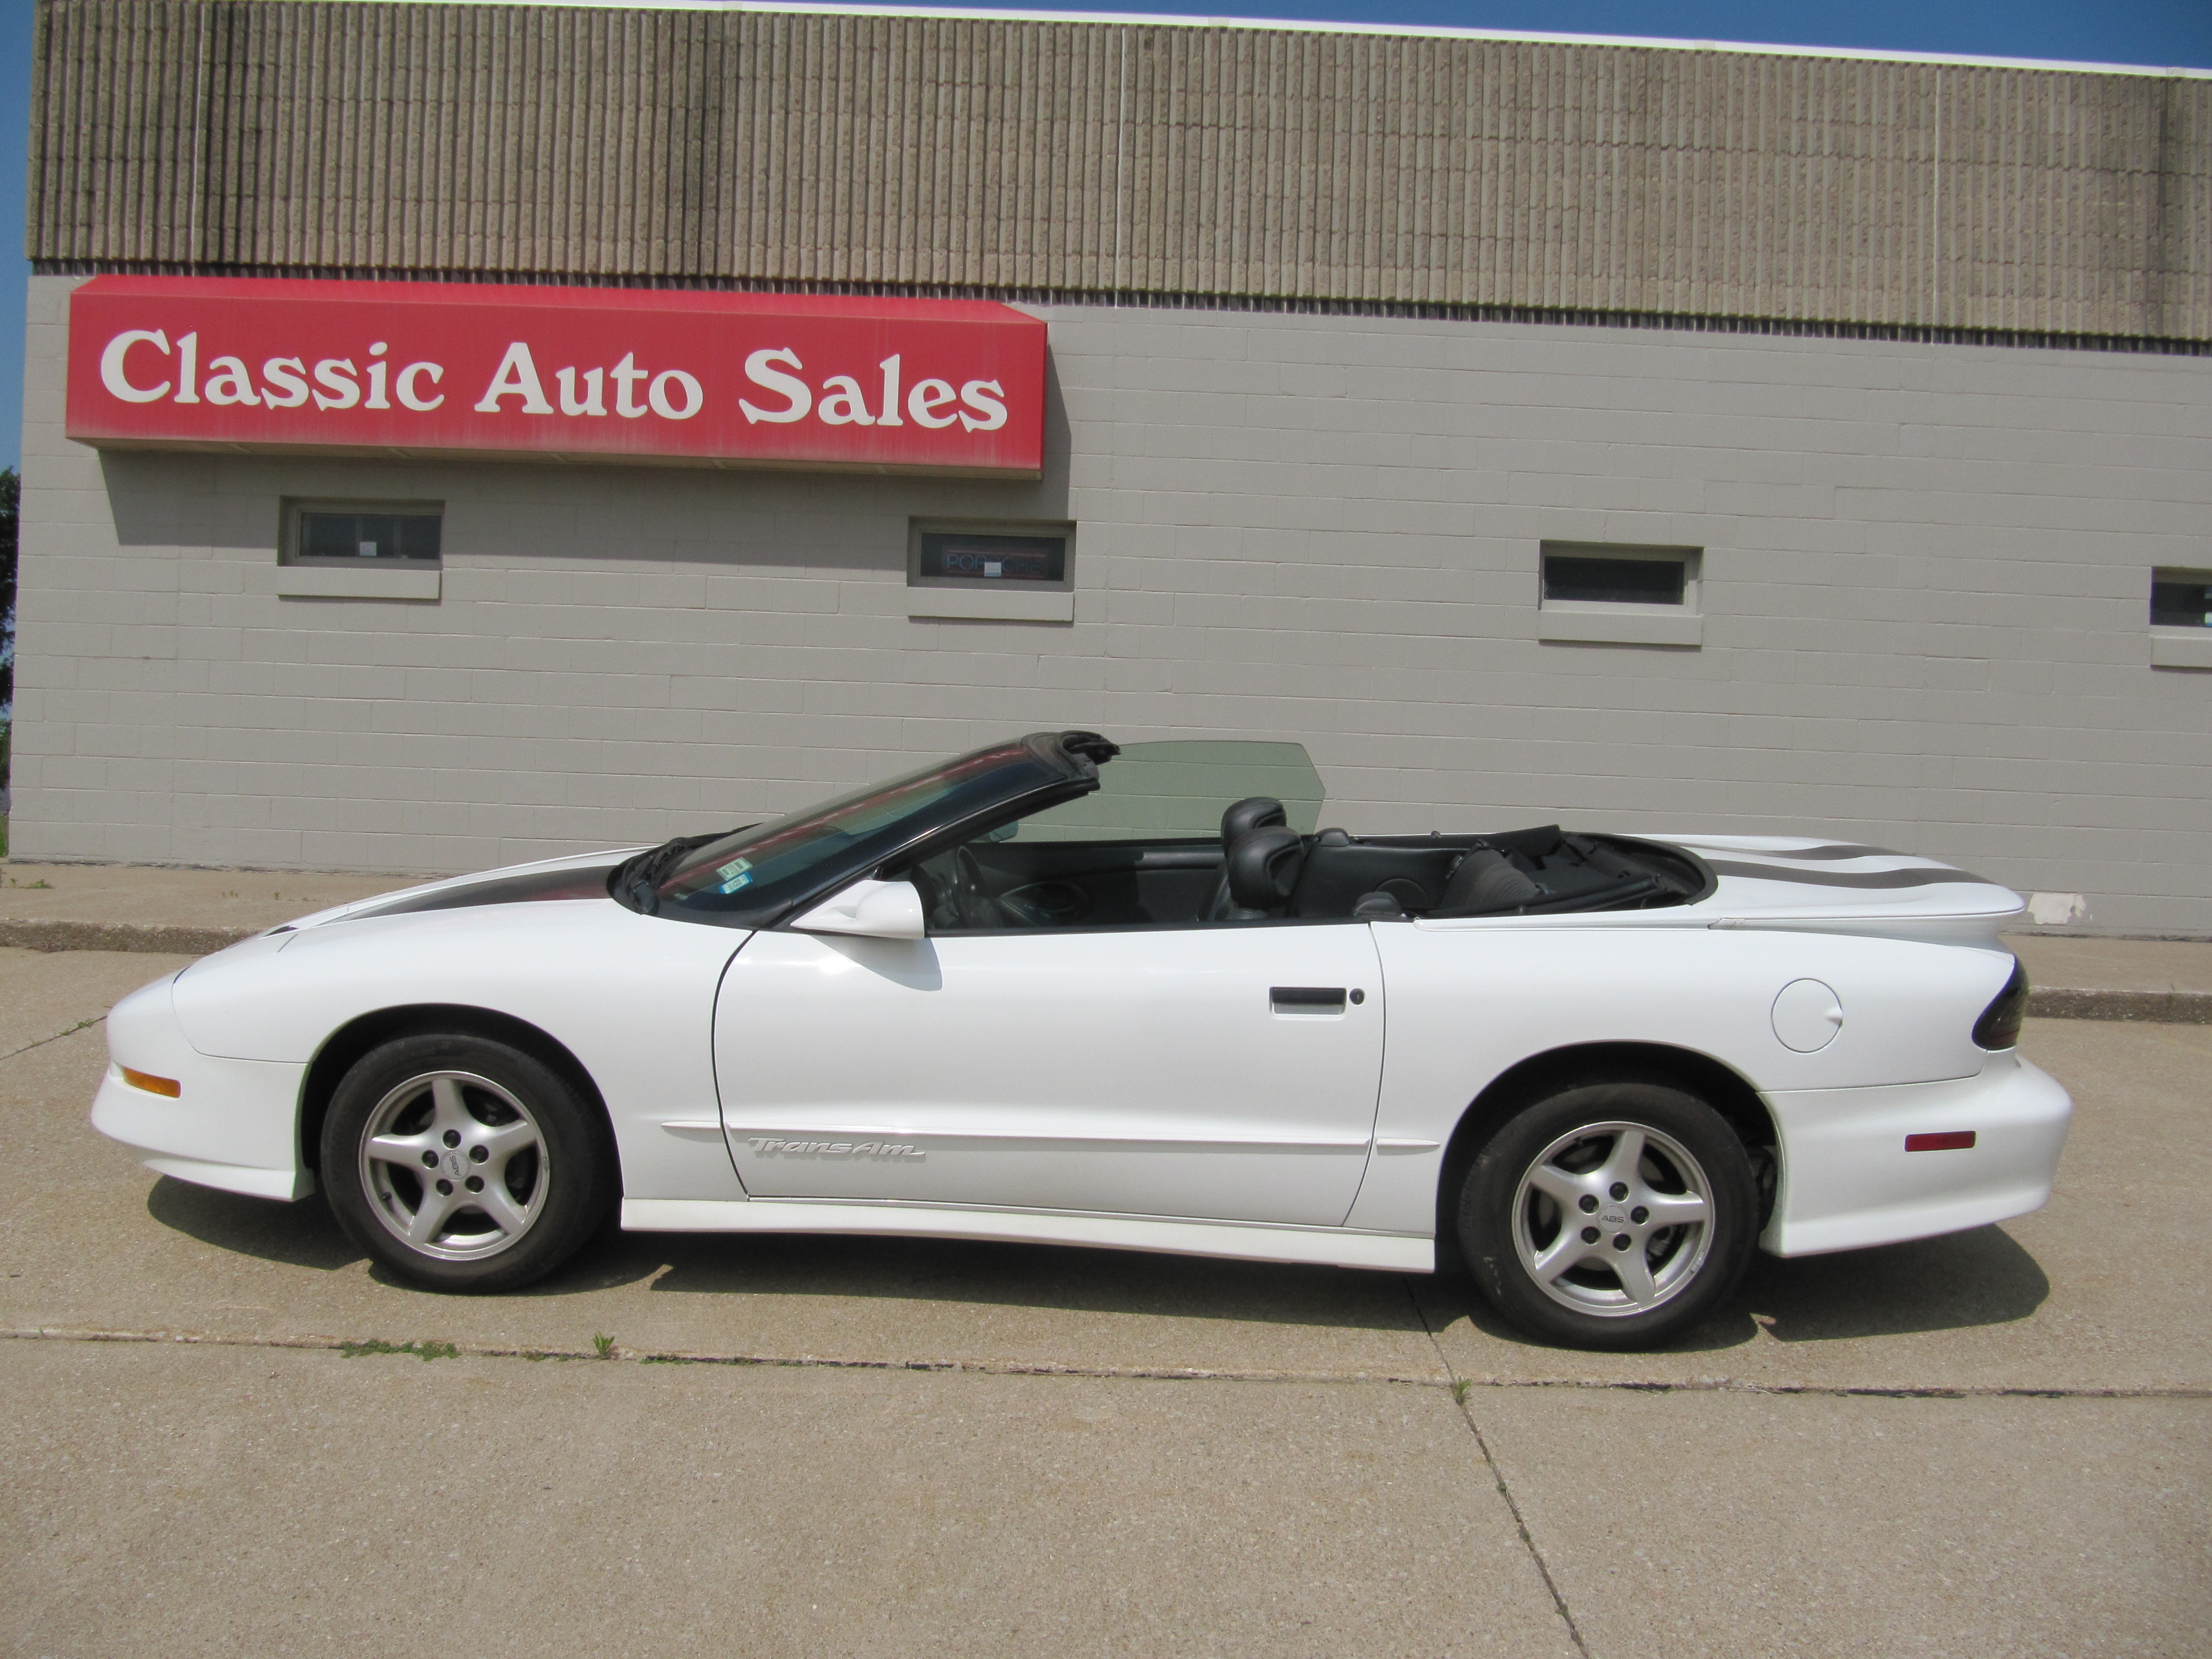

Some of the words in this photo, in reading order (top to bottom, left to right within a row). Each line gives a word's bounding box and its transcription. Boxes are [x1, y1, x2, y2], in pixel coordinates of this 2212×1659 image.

[100, 328, 445, 412] Classic
[473, 341, 704, 420] Auto
[737, 347, 1009, 434] Sales
[450, 1155, 461, 1176] ABS
